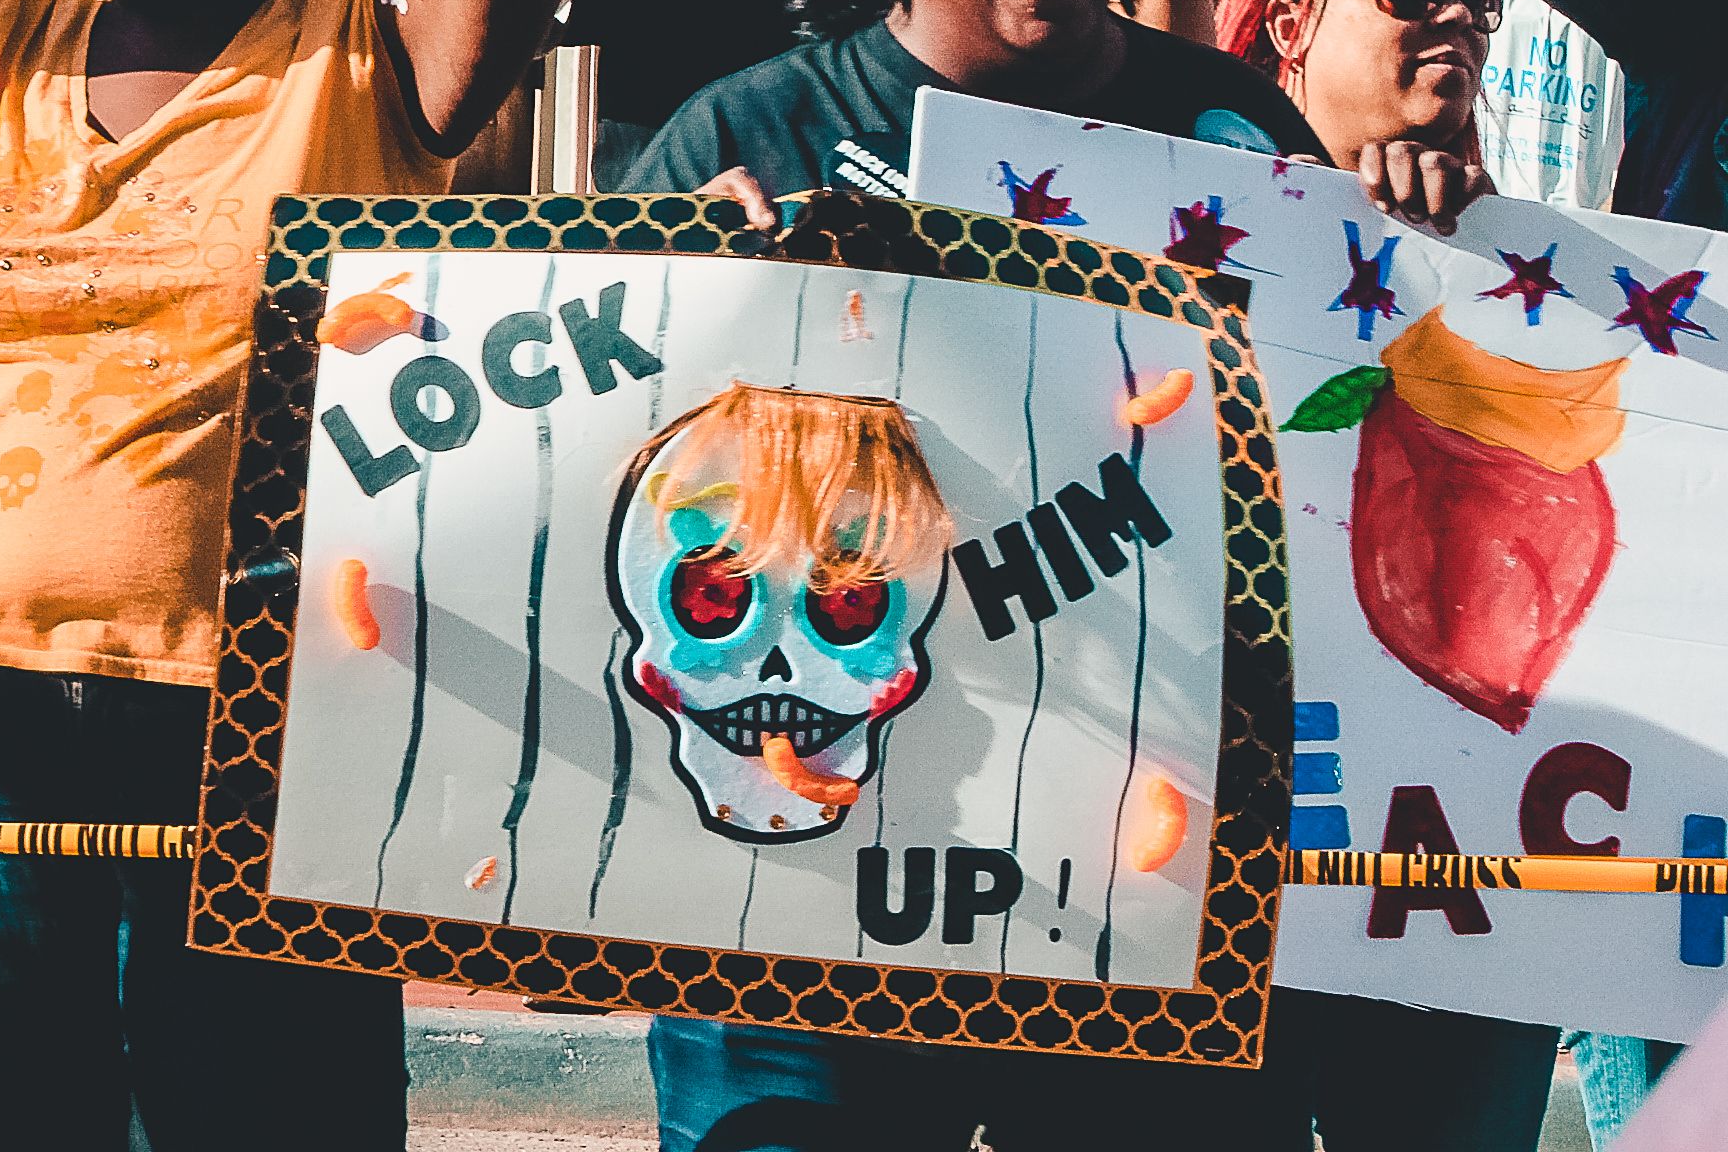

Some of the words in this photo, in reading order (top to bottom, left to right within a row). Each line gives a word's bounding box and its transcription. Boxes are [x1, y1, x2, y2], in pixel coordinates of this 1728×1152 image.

[1483, 64, 1599, 113] PARKING
[1528, 36, 1569, 71] NO
[320, 282, 663, 498] LOCK
[953, 453, 1172, 641] HIM
